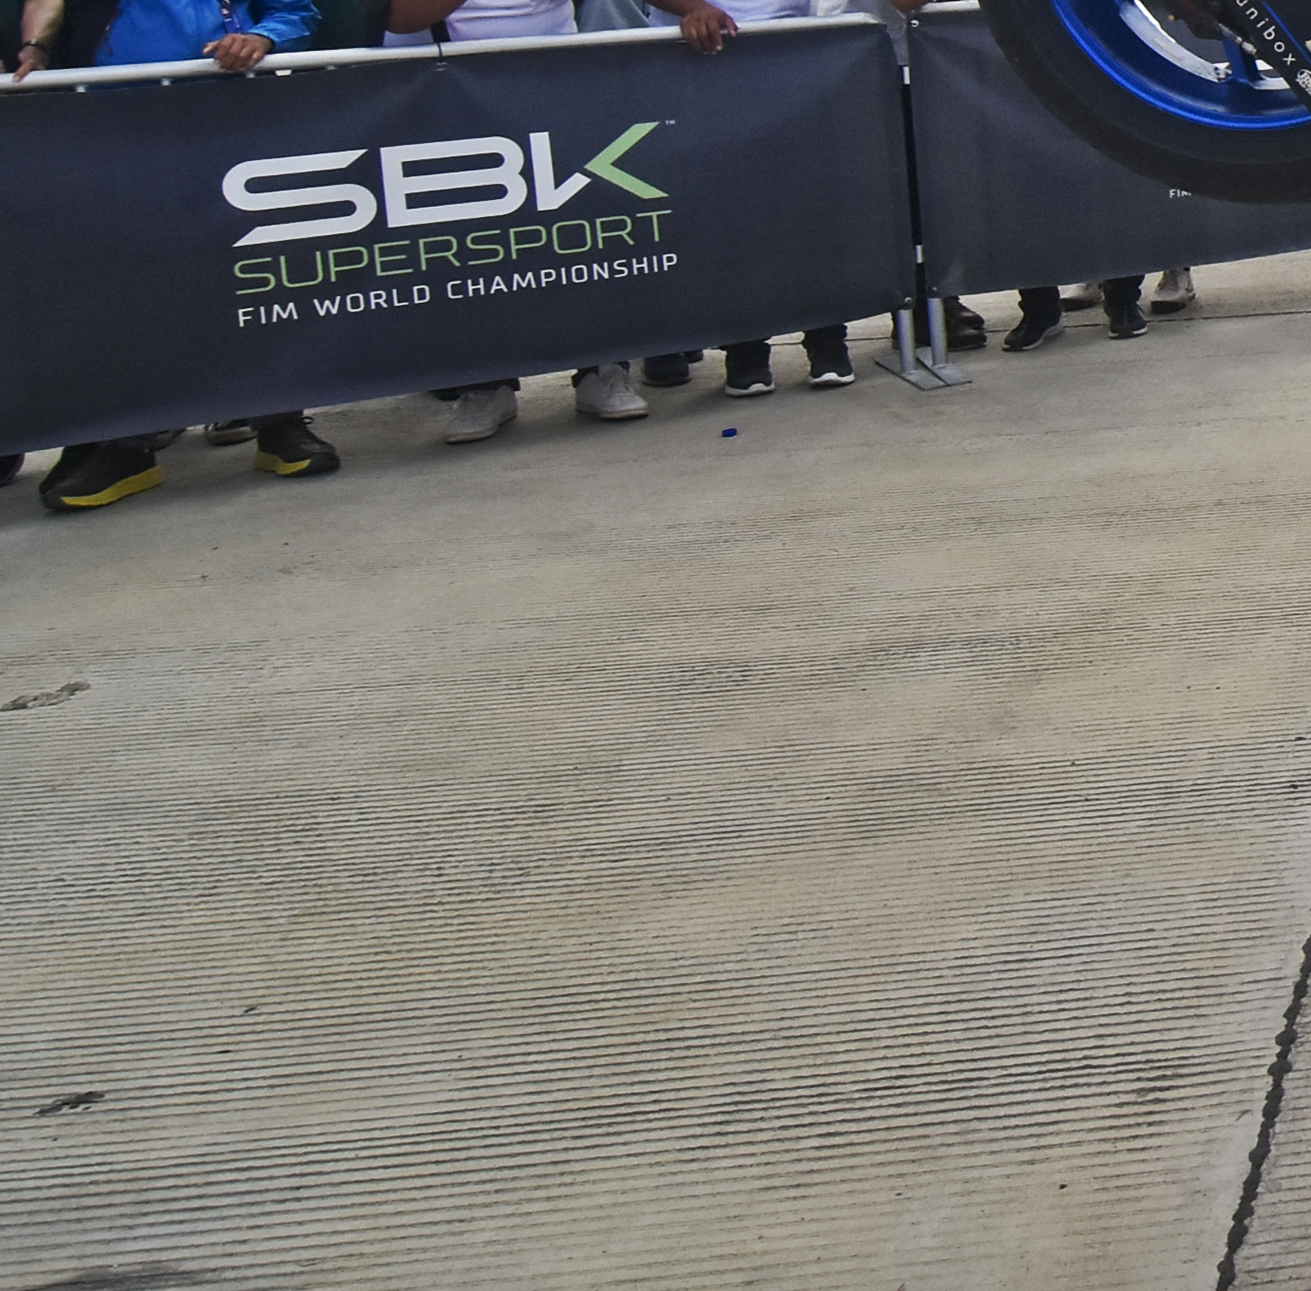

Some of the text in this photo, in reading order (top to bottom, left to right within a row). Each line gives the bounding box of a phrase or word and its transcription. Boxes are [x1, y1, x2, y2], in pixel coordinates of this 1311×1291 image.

[221, 120, 670, 247] SBK
[233, 209, 672, 296] SUPERSPORT
[237, 252, 679, 327] FIM WORLD CHAMPIONSHIP
